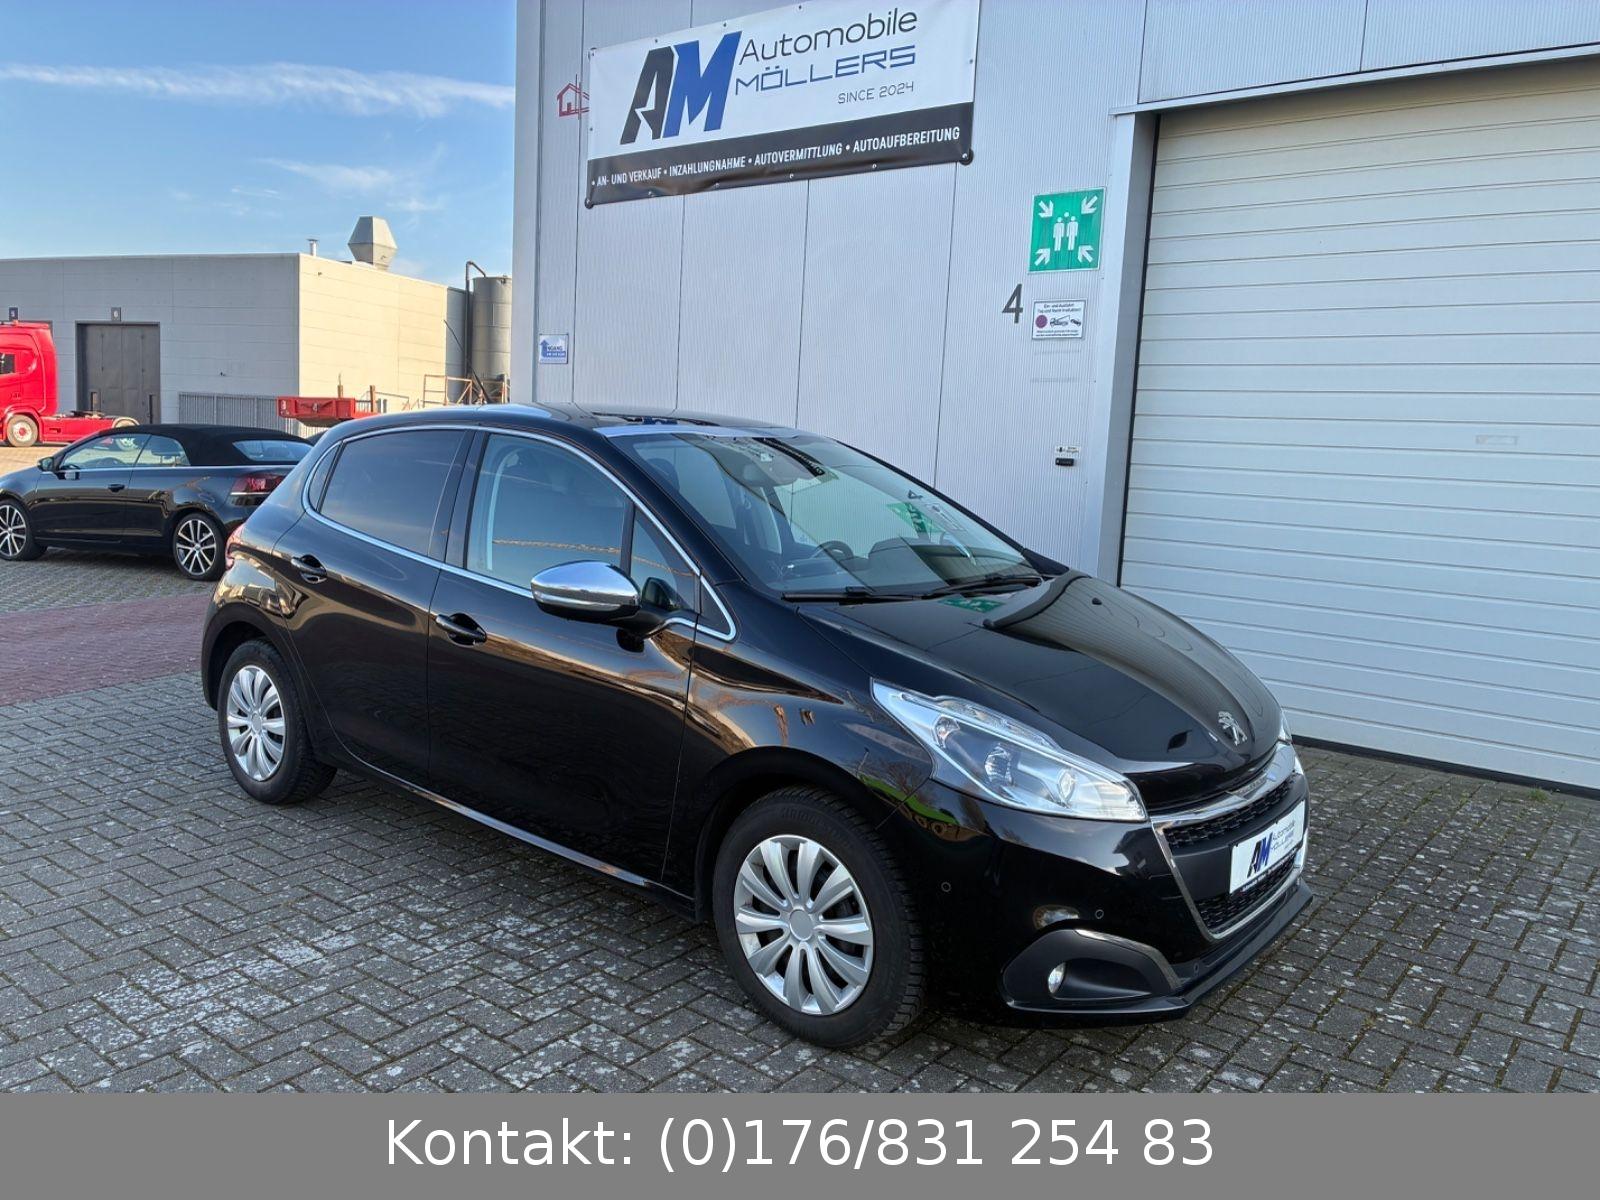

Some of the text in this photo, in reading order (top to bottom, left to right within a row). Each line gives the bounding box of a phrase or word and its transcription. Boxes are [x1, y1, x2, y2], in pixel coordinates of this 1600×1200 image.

[738, 7, 918, 66] Automobile
[620, 31, 742, 145] AM
[735, 45, 916, 95] MÖLLERS
[837, 81, 915, 104] SINCE 2024
[597, 126, 960, 187] AN- UND VERKAUF INZAHLUNGNAHME AUTOVERMITTLUNG AUTOAUFBEREITUNG
[1002, 283, 1023, 324] 4
